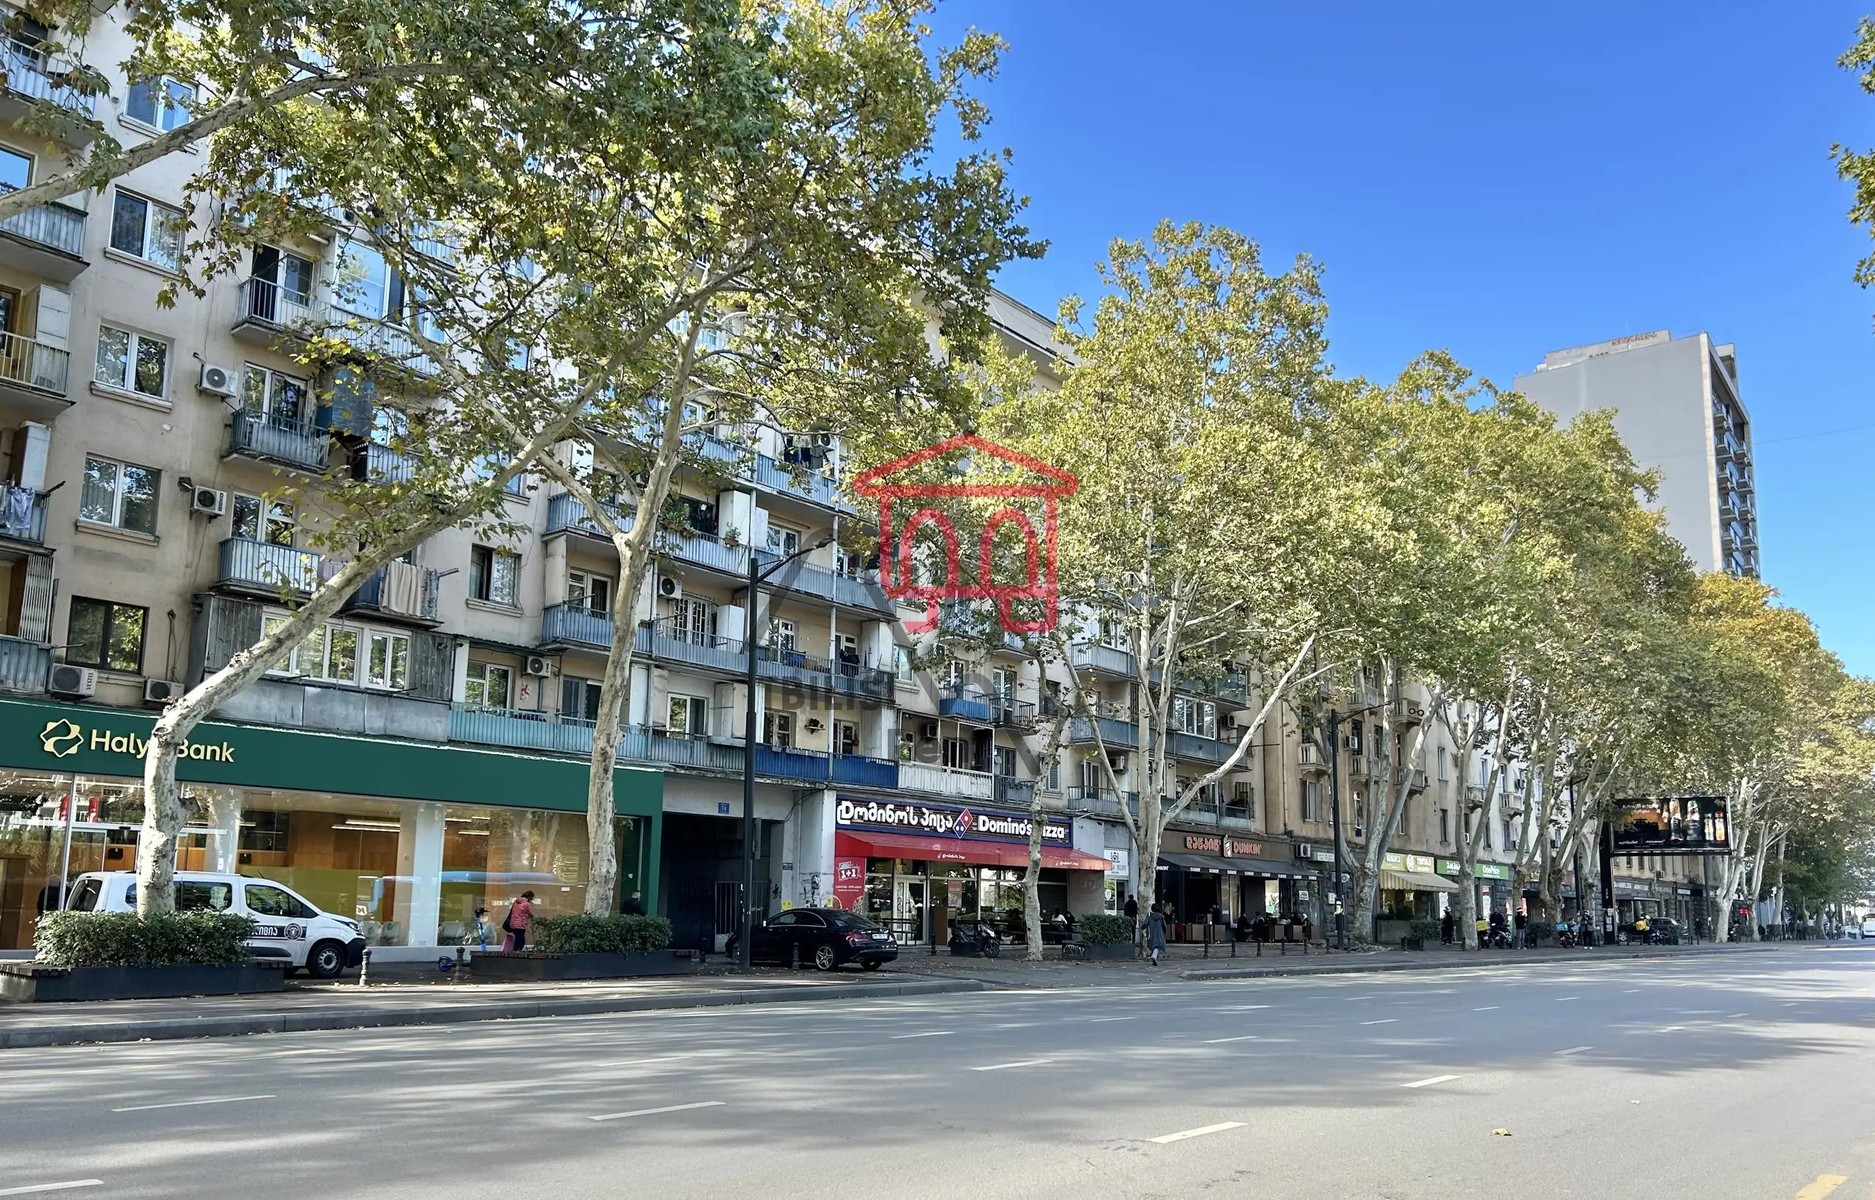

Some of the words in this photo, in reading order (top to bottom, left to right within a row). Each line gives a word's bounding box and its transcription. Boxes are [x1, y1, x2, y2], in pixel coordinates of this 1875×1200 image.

[90, 729, 150, 760] Haly
[920, 807, 953, 833] პიცა
[978, 815, 1033, 837] Domino's
[1042, 825, 1065, 839] izza
